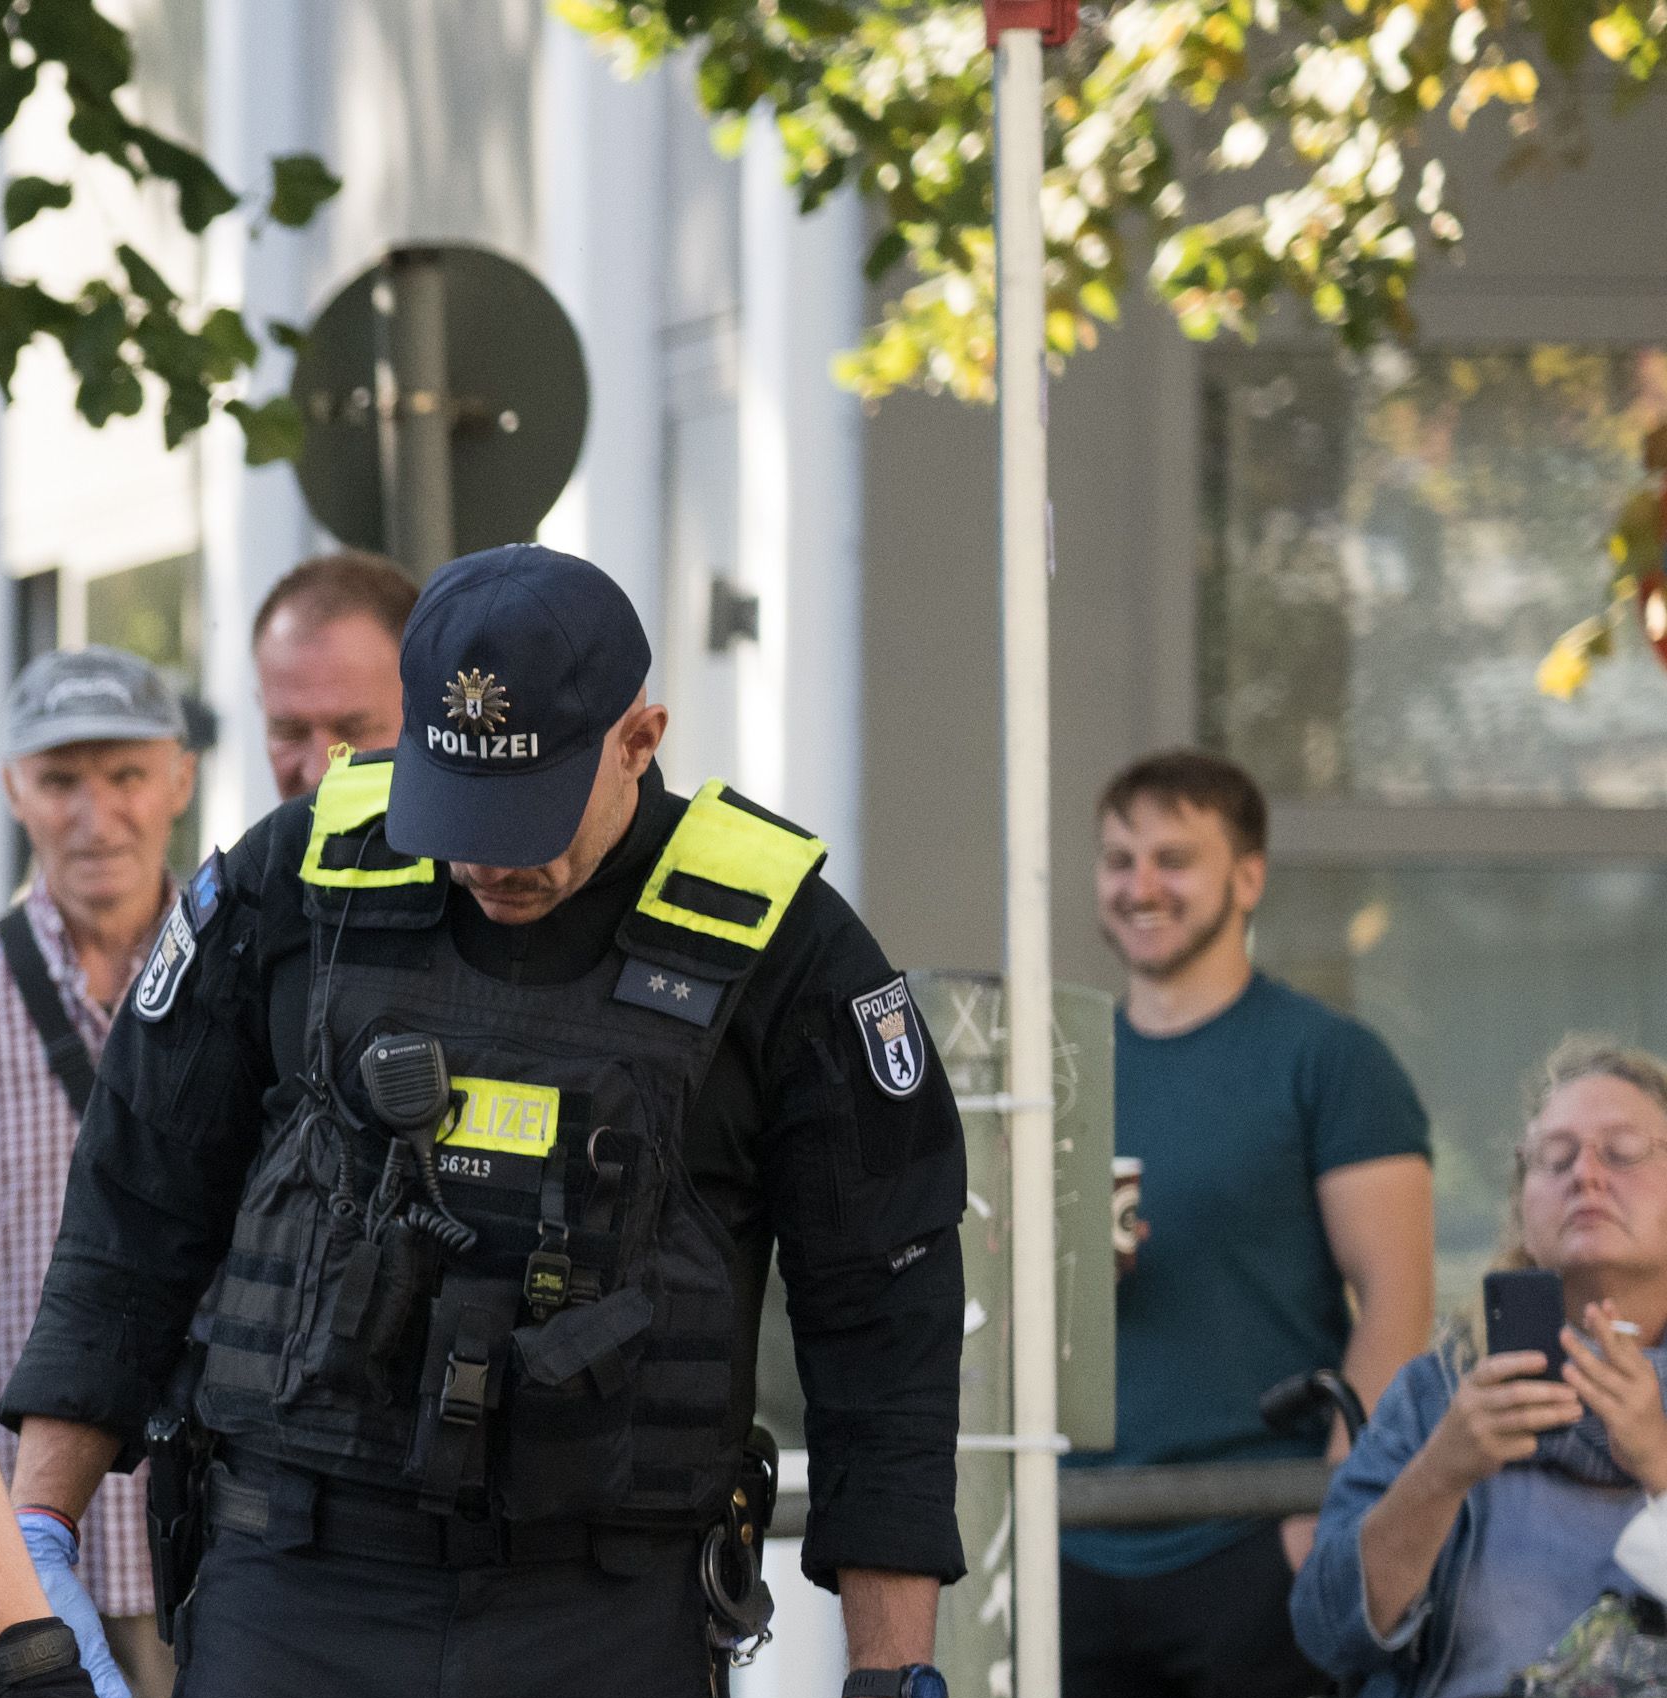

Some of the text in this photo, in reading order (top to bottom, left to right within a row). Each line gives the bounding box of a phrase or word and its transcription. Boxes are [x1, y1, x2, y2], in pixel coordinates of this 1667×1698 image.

[427, 724, 539, 759] POLIZEI
[859, 984, 907, 1022] POLIZEI
[444, 1093, 550, 1142] LIZEI
[437, 1153, 492, 1178] 56213
